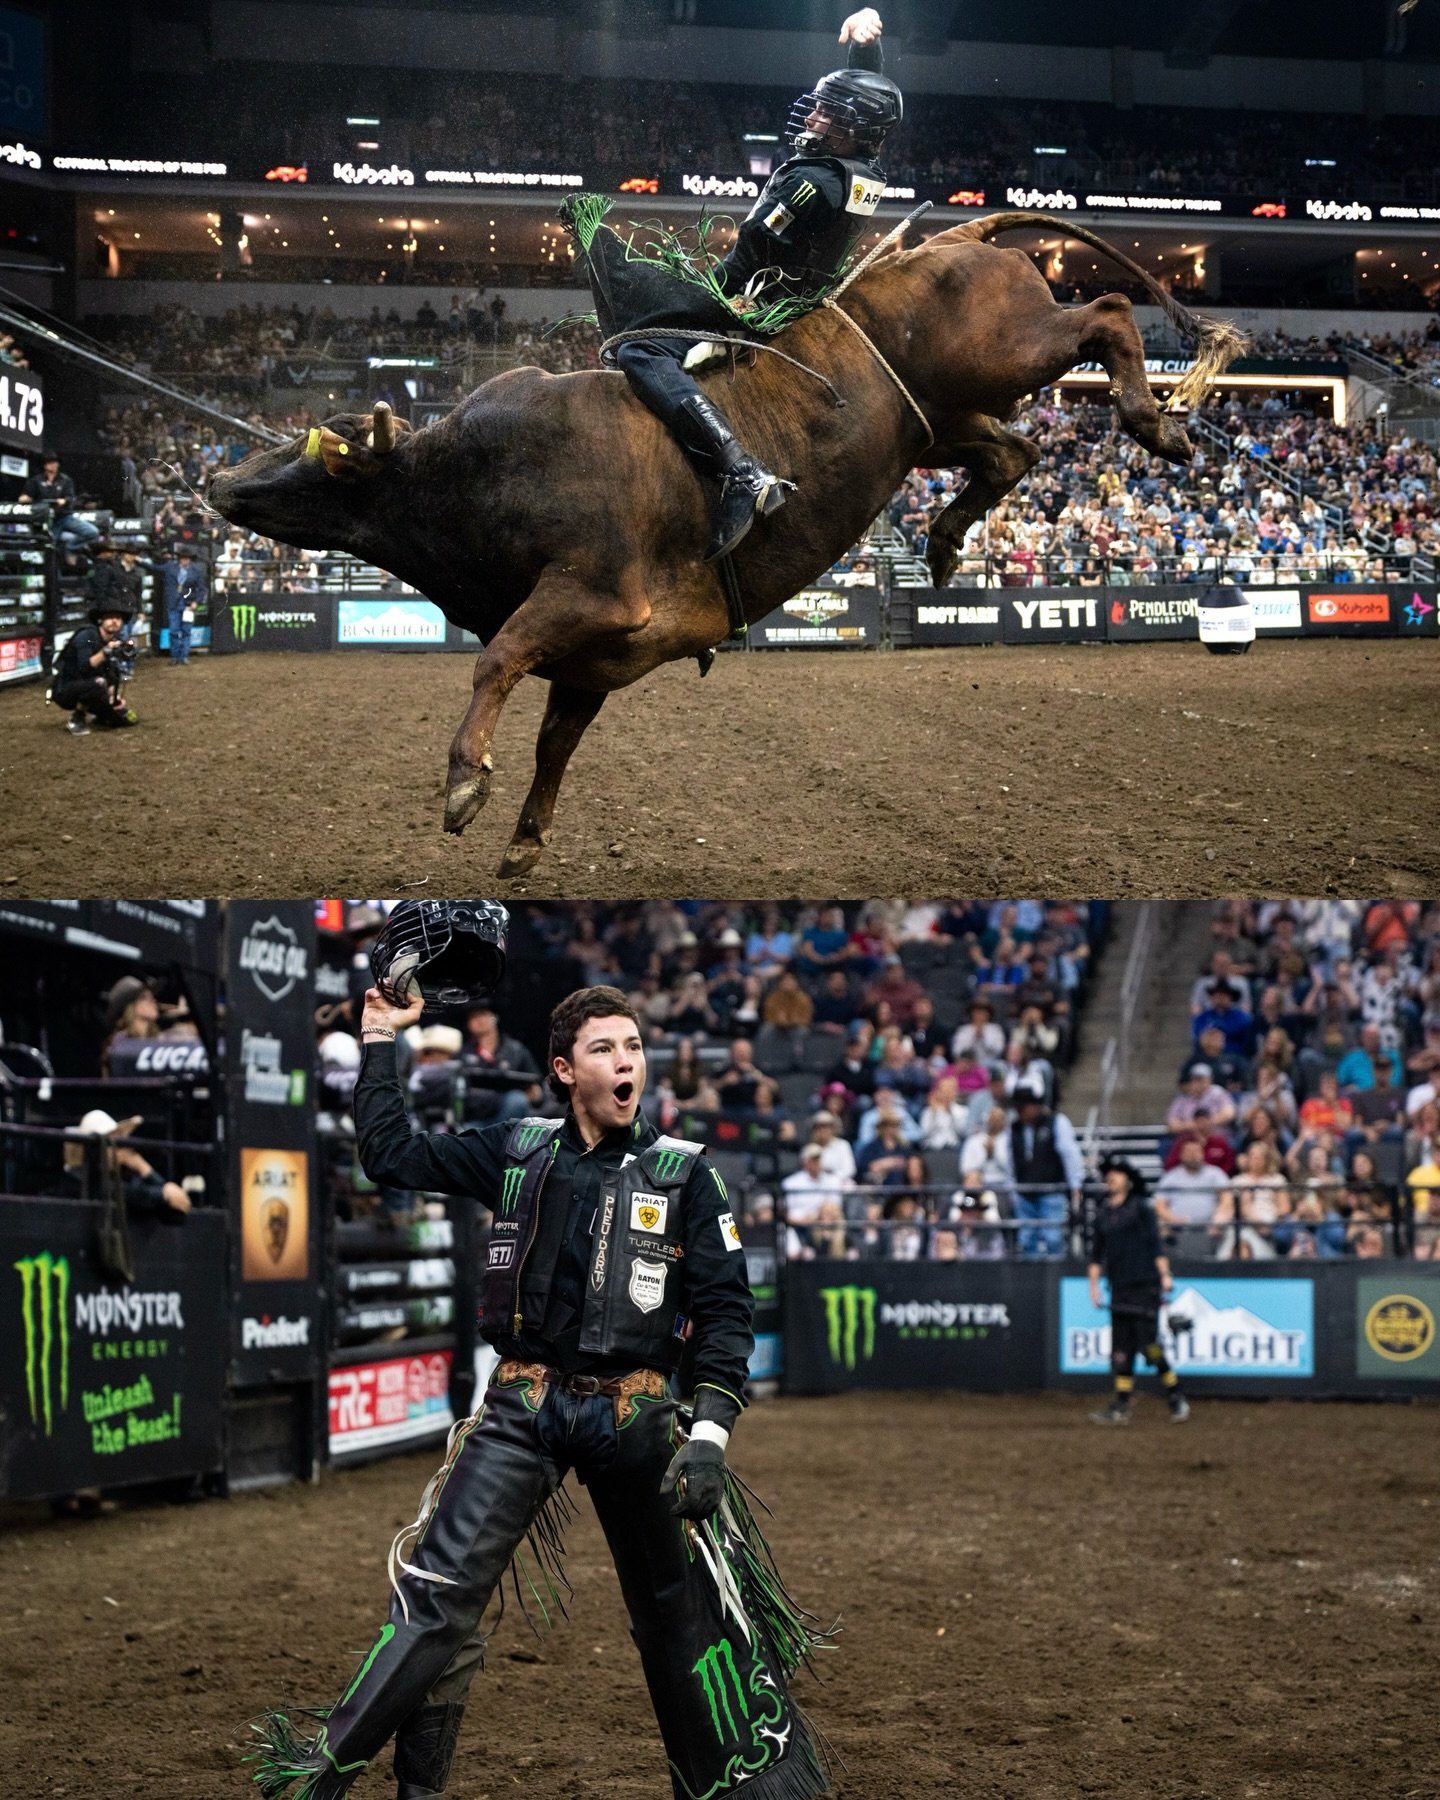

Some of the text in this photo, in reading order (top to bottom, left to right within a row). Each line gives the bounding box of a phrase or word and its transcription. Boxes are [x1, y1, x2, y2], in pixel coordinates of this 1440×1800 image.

[333, 163, 415, 186] Kubota
[682, 174, 759, 197] Kubota
[1006, 187, 1078, 210] Kubota
[1306, 200, 1372, 221] Kubota
[1164, 360, 1198, 373] CLU
[258, 611, 316, 623] MONSTER
[917, 606, 999, 624] BOOT BARN
[1012, 599, 1098, 629] YETI
[1129, 598, 1199, 619] PENDLETON
[1337, 603, 1384, 615] Kubota
[1145, 616, 1183, 624] WHISKY
[240, 937, 308, 979] LUCAS OIL
[136, 1046, 210, 1071] LUCA
[634, 1196, 667, 1207] ARIAT
[489, 1246, 512, 1264] YETI
[75, 1285, 185, 1336] MONSTER
[880, 1299, 1011, 1328] MONSTER
[91, 1339, 169, 1361] ENERGY
